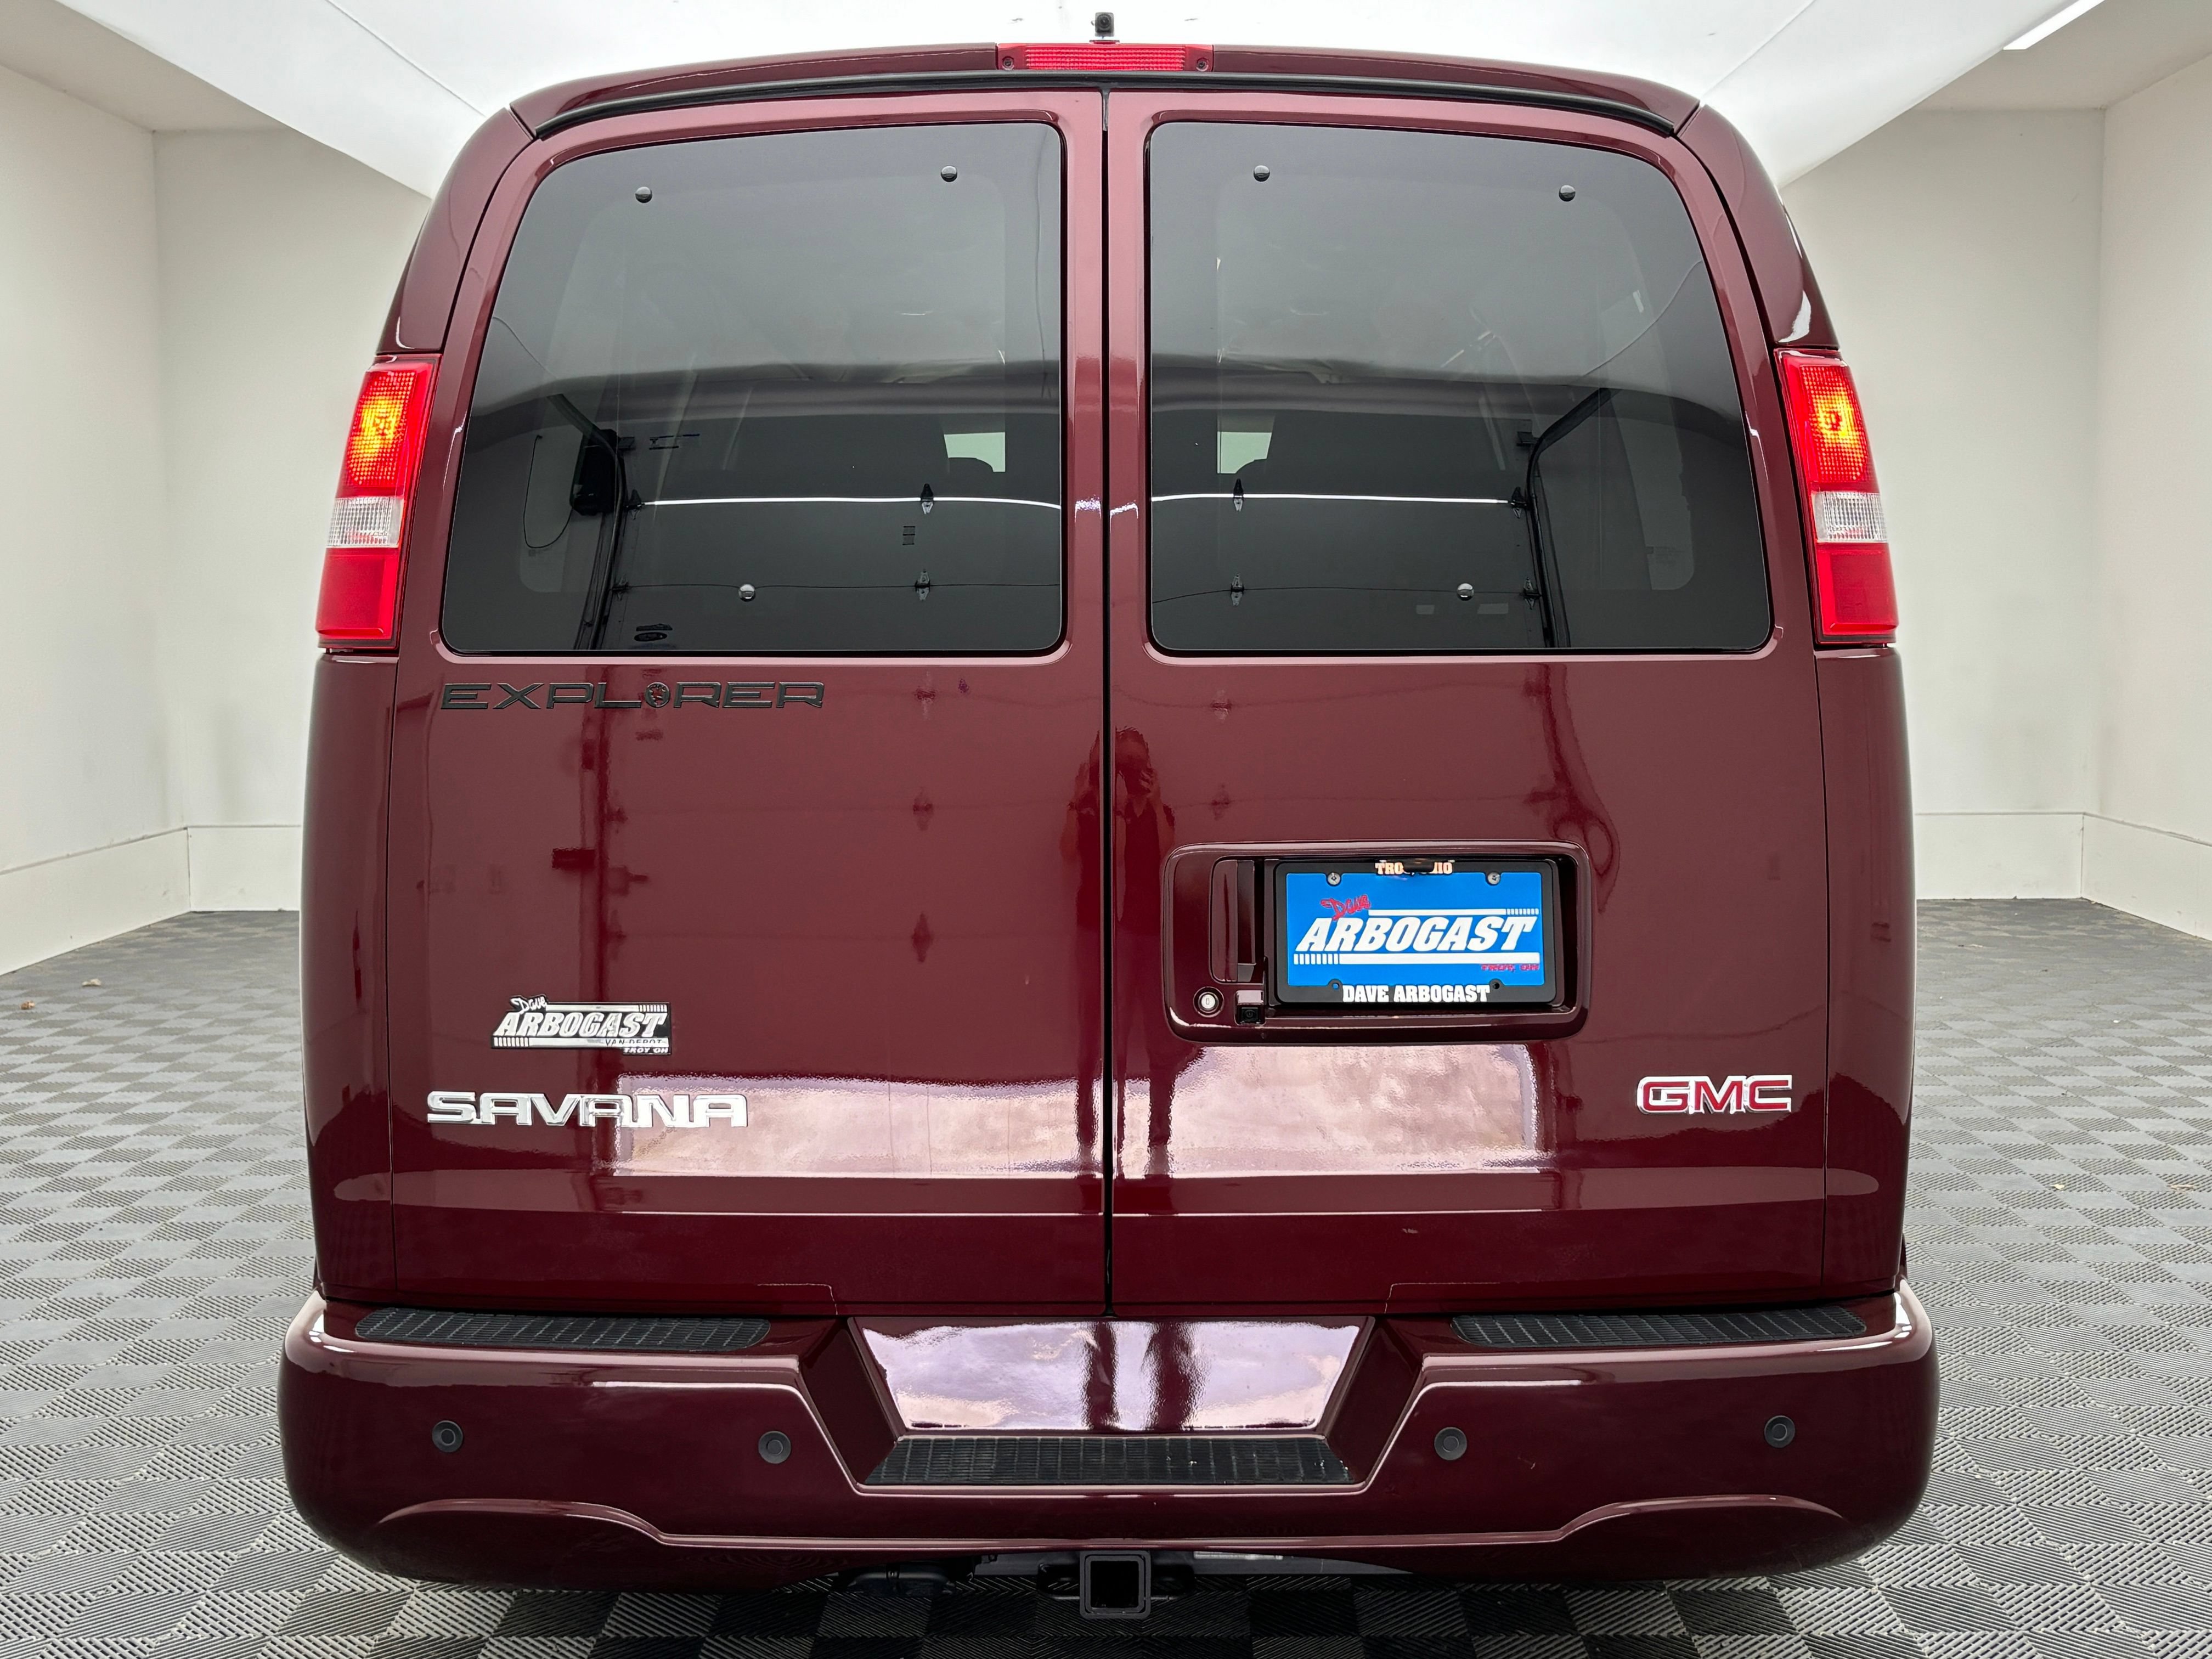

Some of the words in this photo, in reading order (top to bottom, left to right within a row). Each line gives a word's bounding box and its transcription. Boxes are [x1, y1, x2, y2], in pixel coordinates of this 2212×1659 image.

[441, 681, 825, 710] EXPLORER
[1320, 894, 1370, 921] Dave
[1295, 917, 1538, 951] ARBOGAST
[510, 996, 548, 1014] Dave
[1342, 985, 1389, 1002] DAVE
[1393, 985, 1490, 1002] ARBOGAST
[493, 1012, 668, 1037] ARBOGAST
[1637, 1075, 1792, 1114] GMC
[427, 1091, 748, 1127] SAVANA
